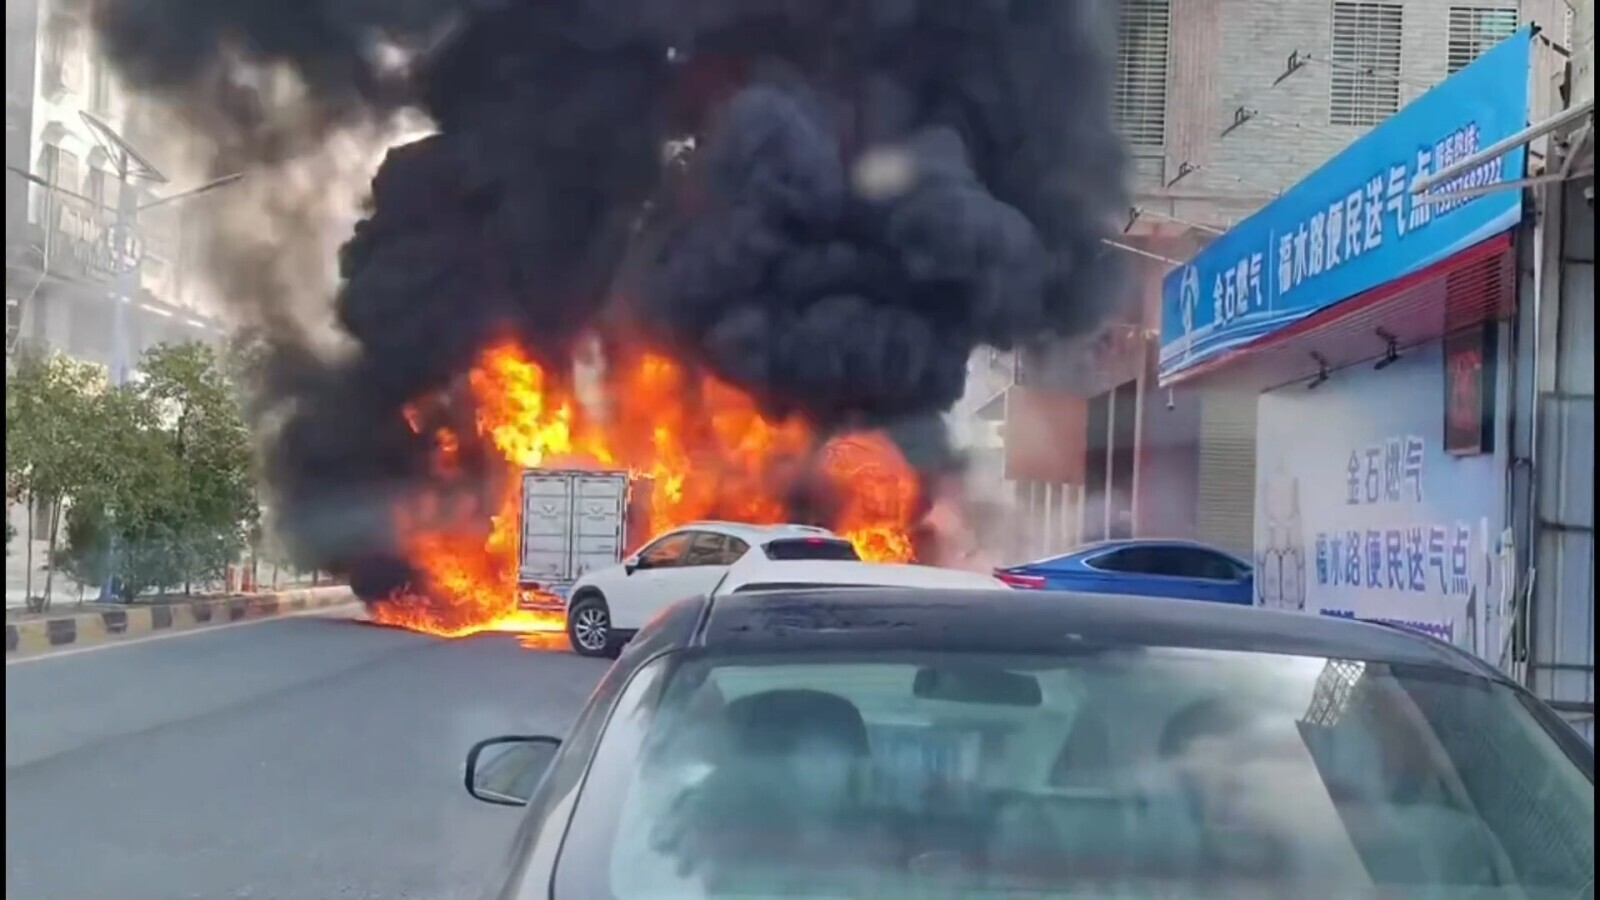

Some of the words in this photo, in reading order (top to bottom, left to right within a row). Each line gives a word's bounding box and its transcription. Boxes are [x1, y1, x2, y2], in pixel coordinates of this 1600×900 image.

[1278, 149, 1432, 296] 福水路便民送气点
[1213, 252, 1262, 326] 金石燃气
[1346, 439, 1422, 506] 金石燃气
[1315, 526, 1469, 597] 福水路便民送气点
